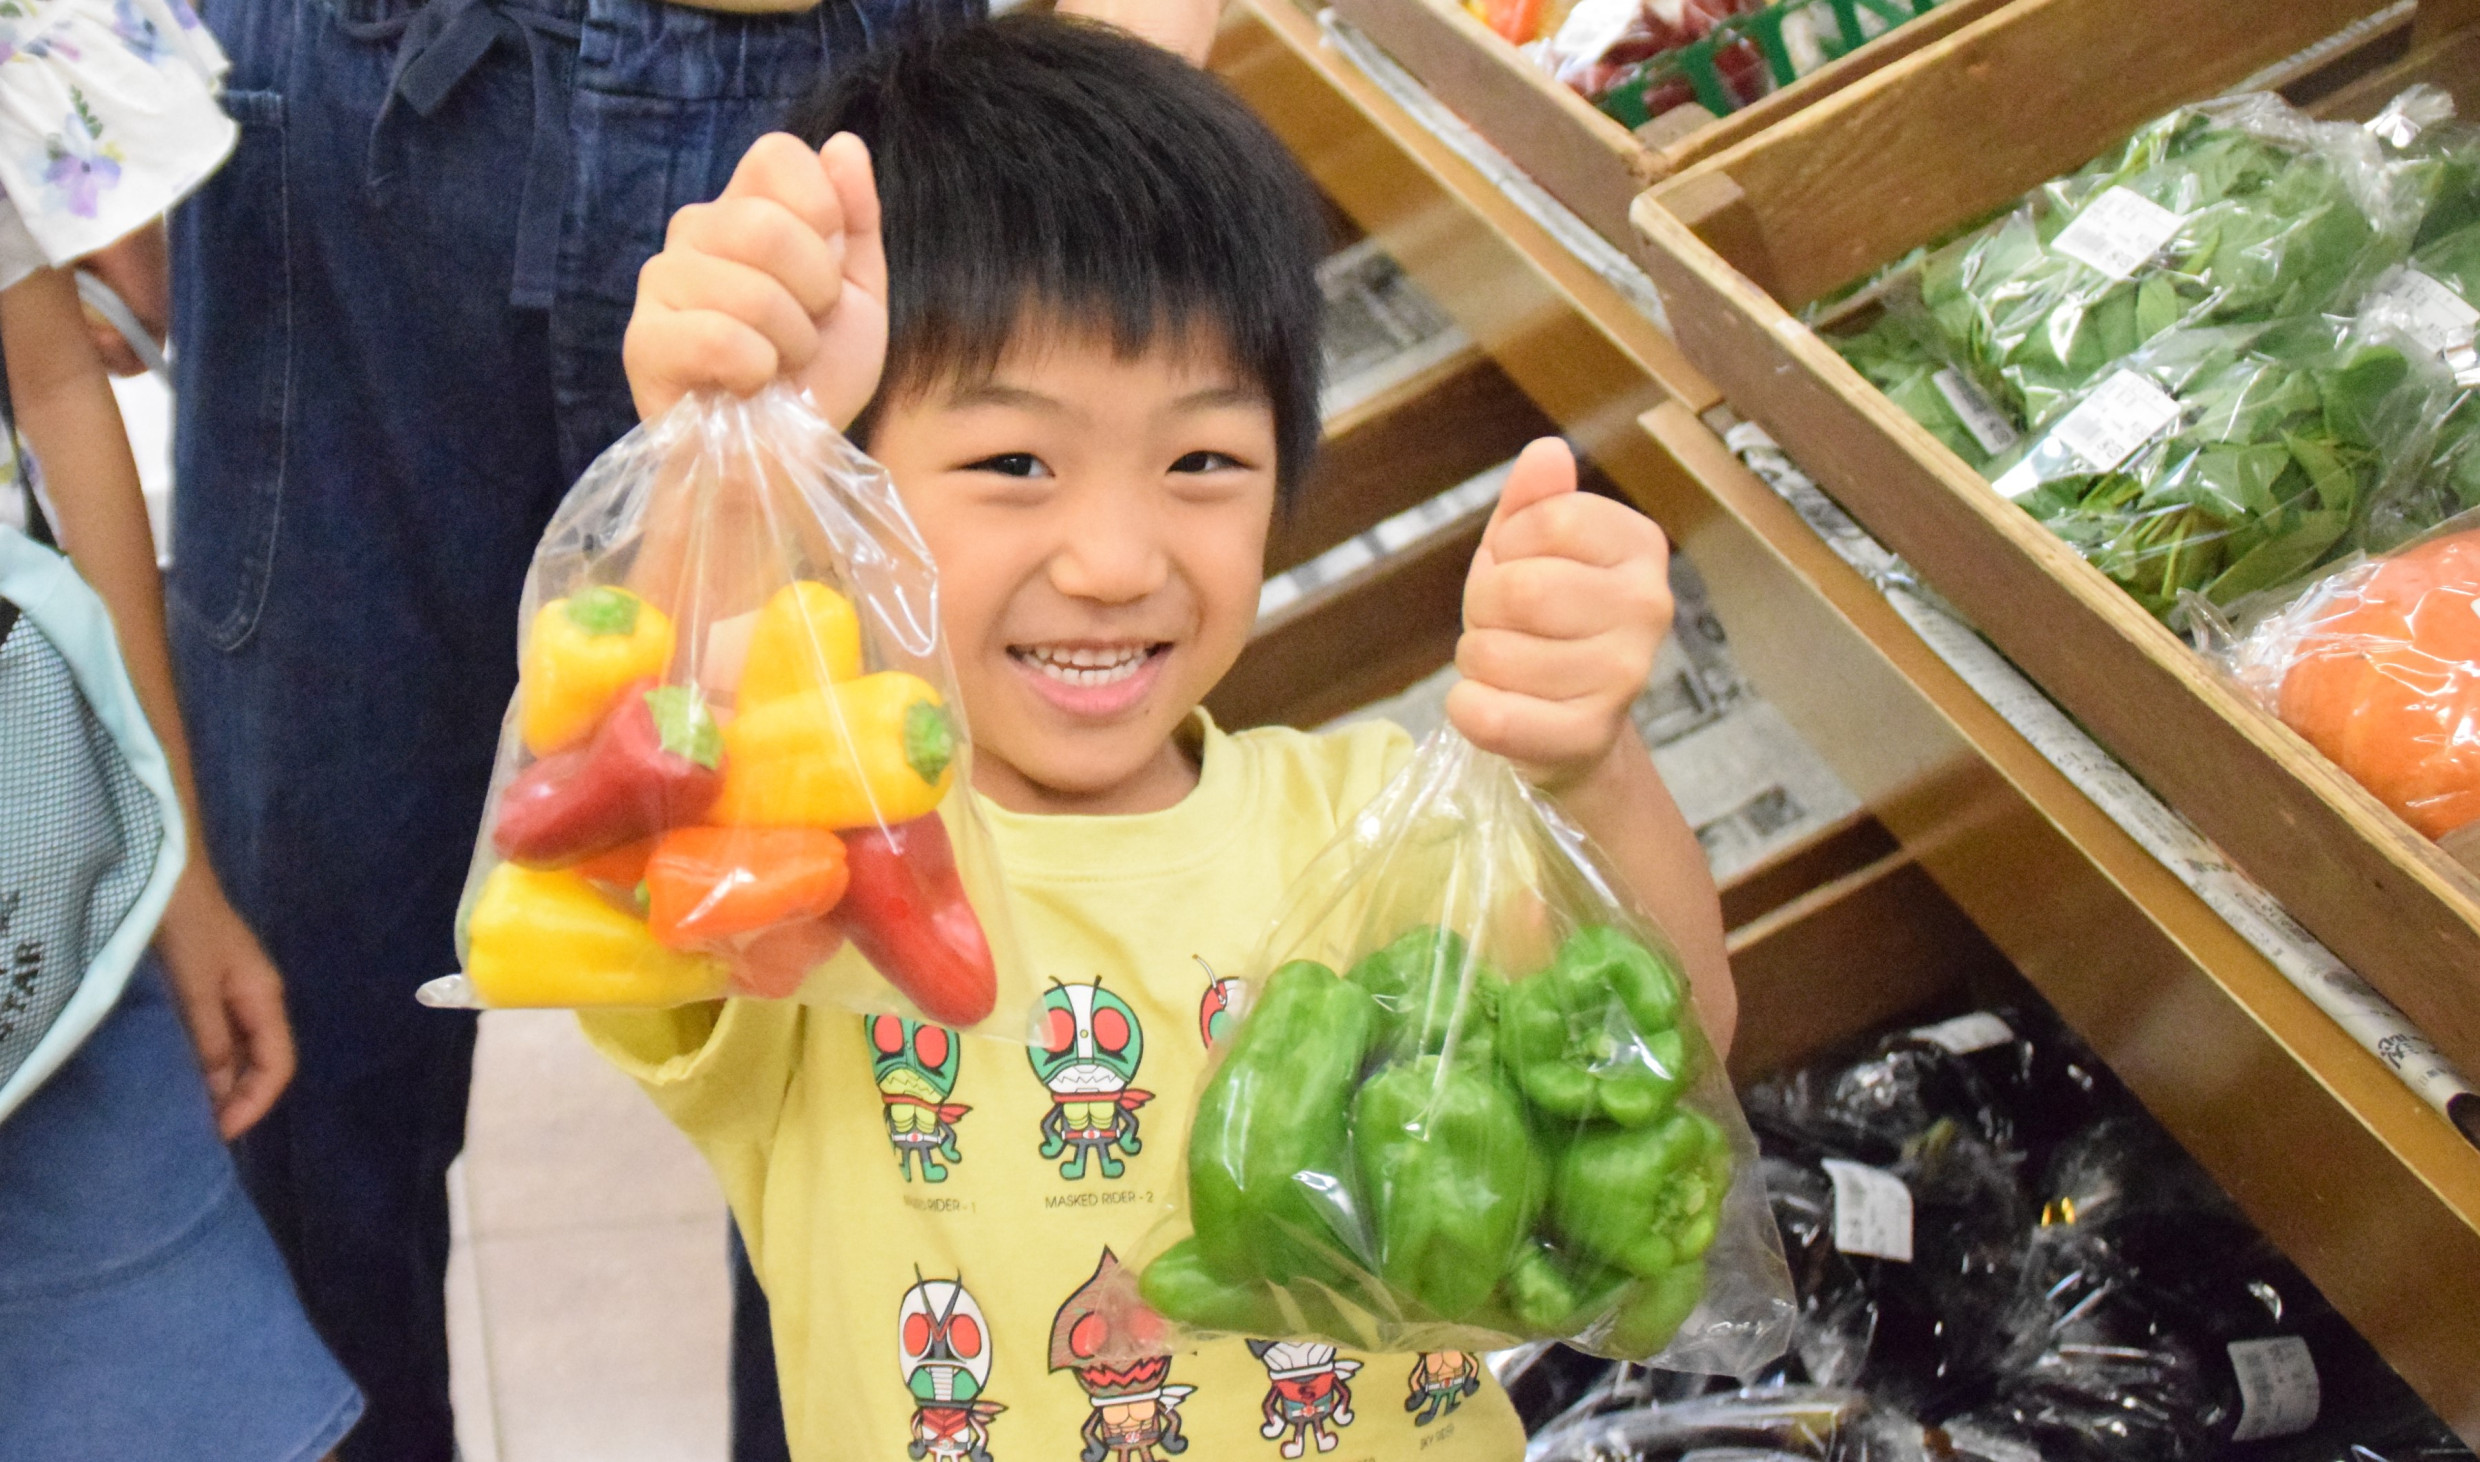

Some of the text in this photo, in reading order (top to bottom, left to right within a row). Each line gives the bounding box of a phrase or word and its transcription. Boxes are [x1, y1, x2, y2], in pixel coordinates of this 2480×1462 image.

[1044, 1193, 1099, 1209] MASKED
[1101, 1191, 1136, 1205] RIDER
[1145, 1191, 1155, 1204] 2
